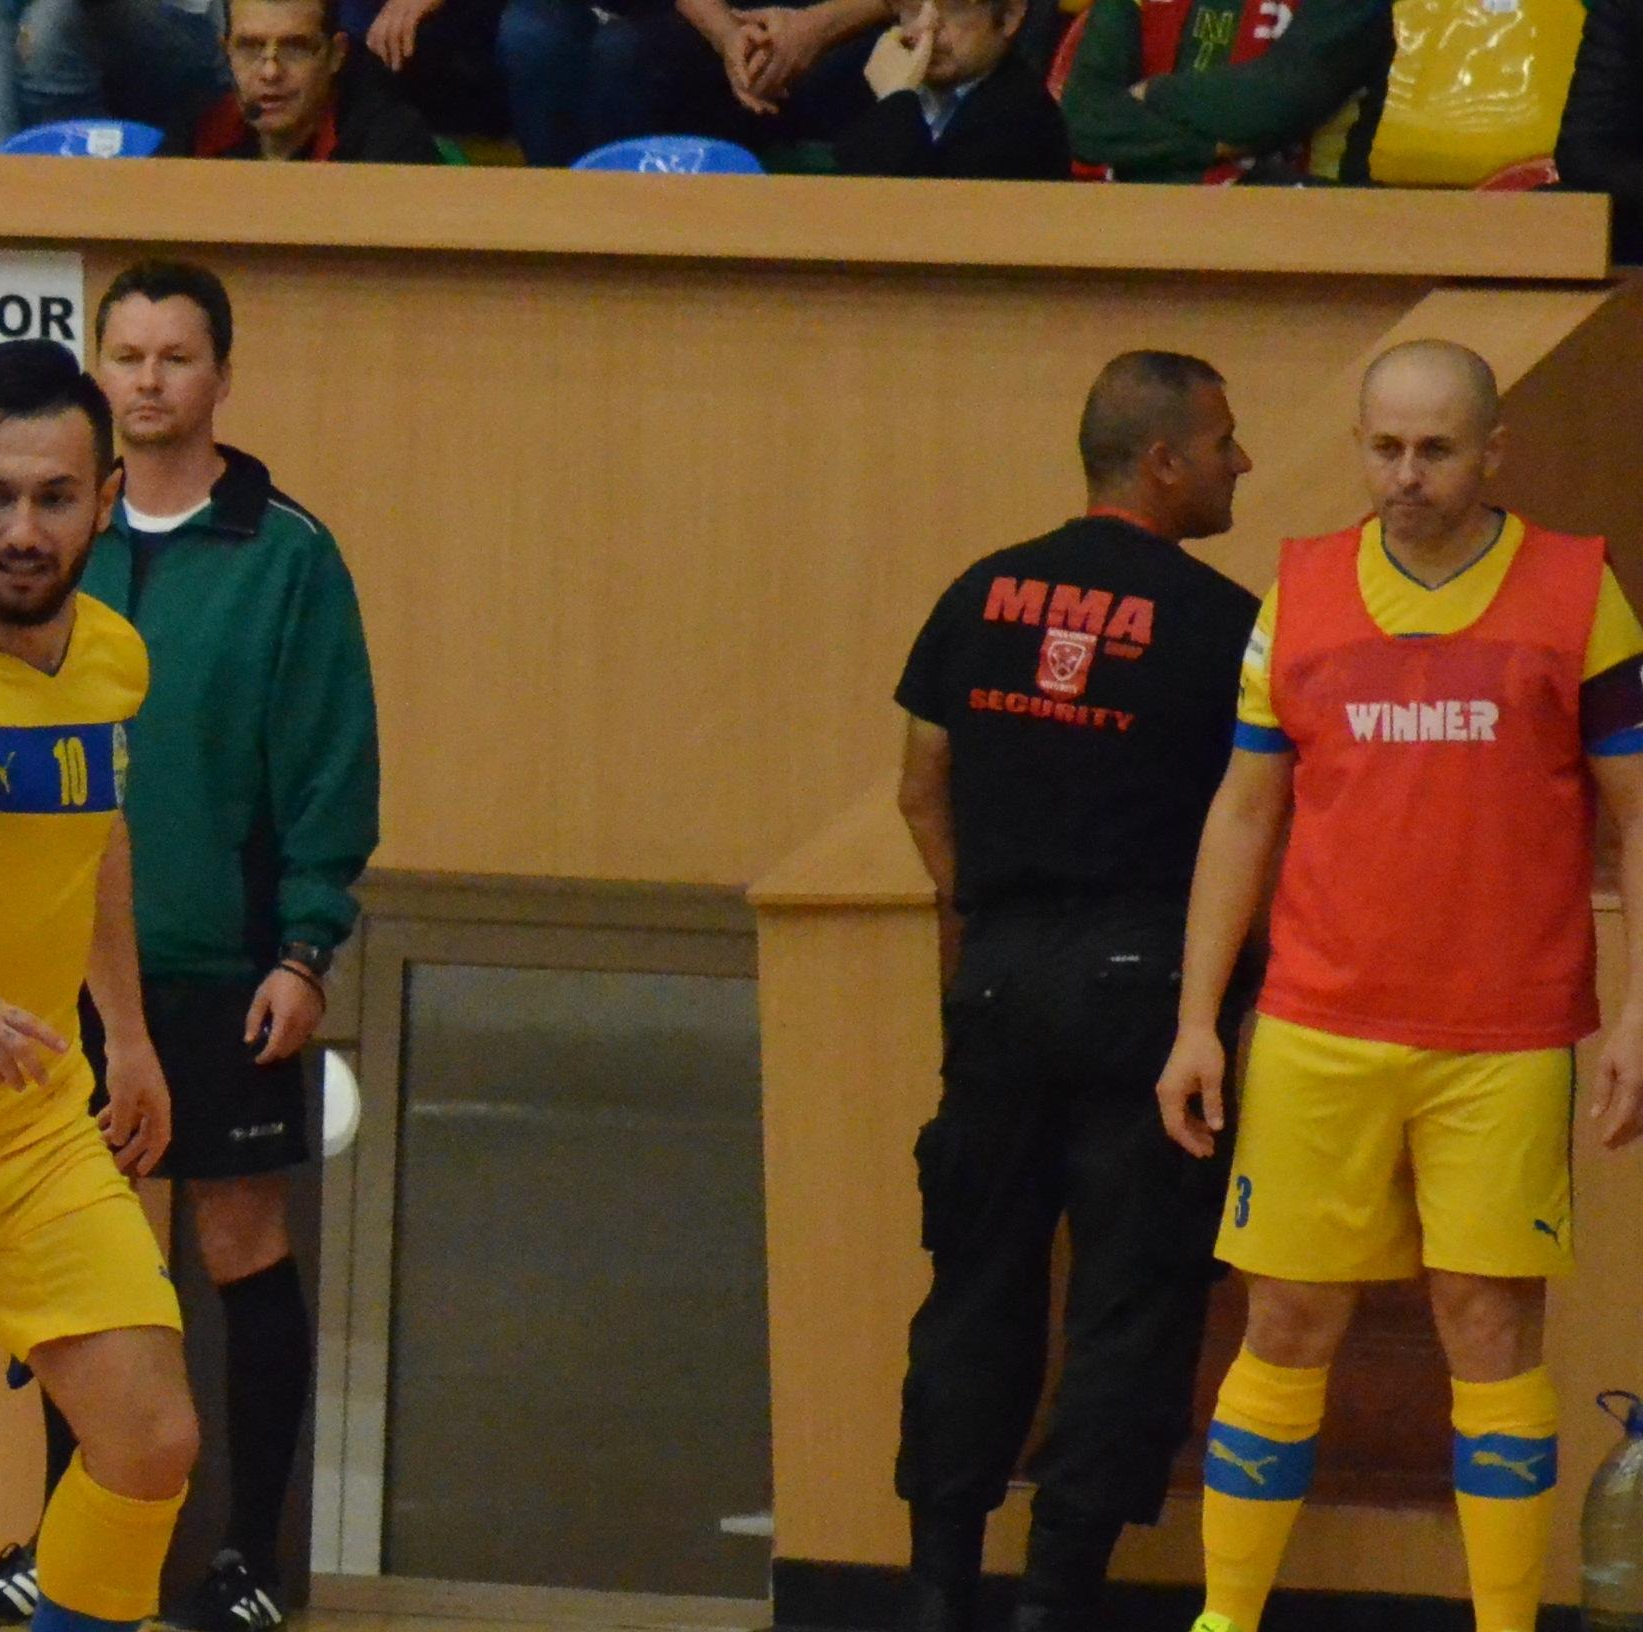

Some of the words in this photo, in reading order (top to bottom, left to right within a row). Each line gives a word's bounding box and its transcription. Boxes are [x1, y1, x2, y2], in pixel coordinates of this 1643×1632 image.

[982, 576, 1155, 645] MMA
[969, 688, 1135, 731] SECURITY
[1345, 699, 1500, 743] WINNER
[53, 736, 88, 806] 10
[1235, 1175, 1252, 1228] 3
